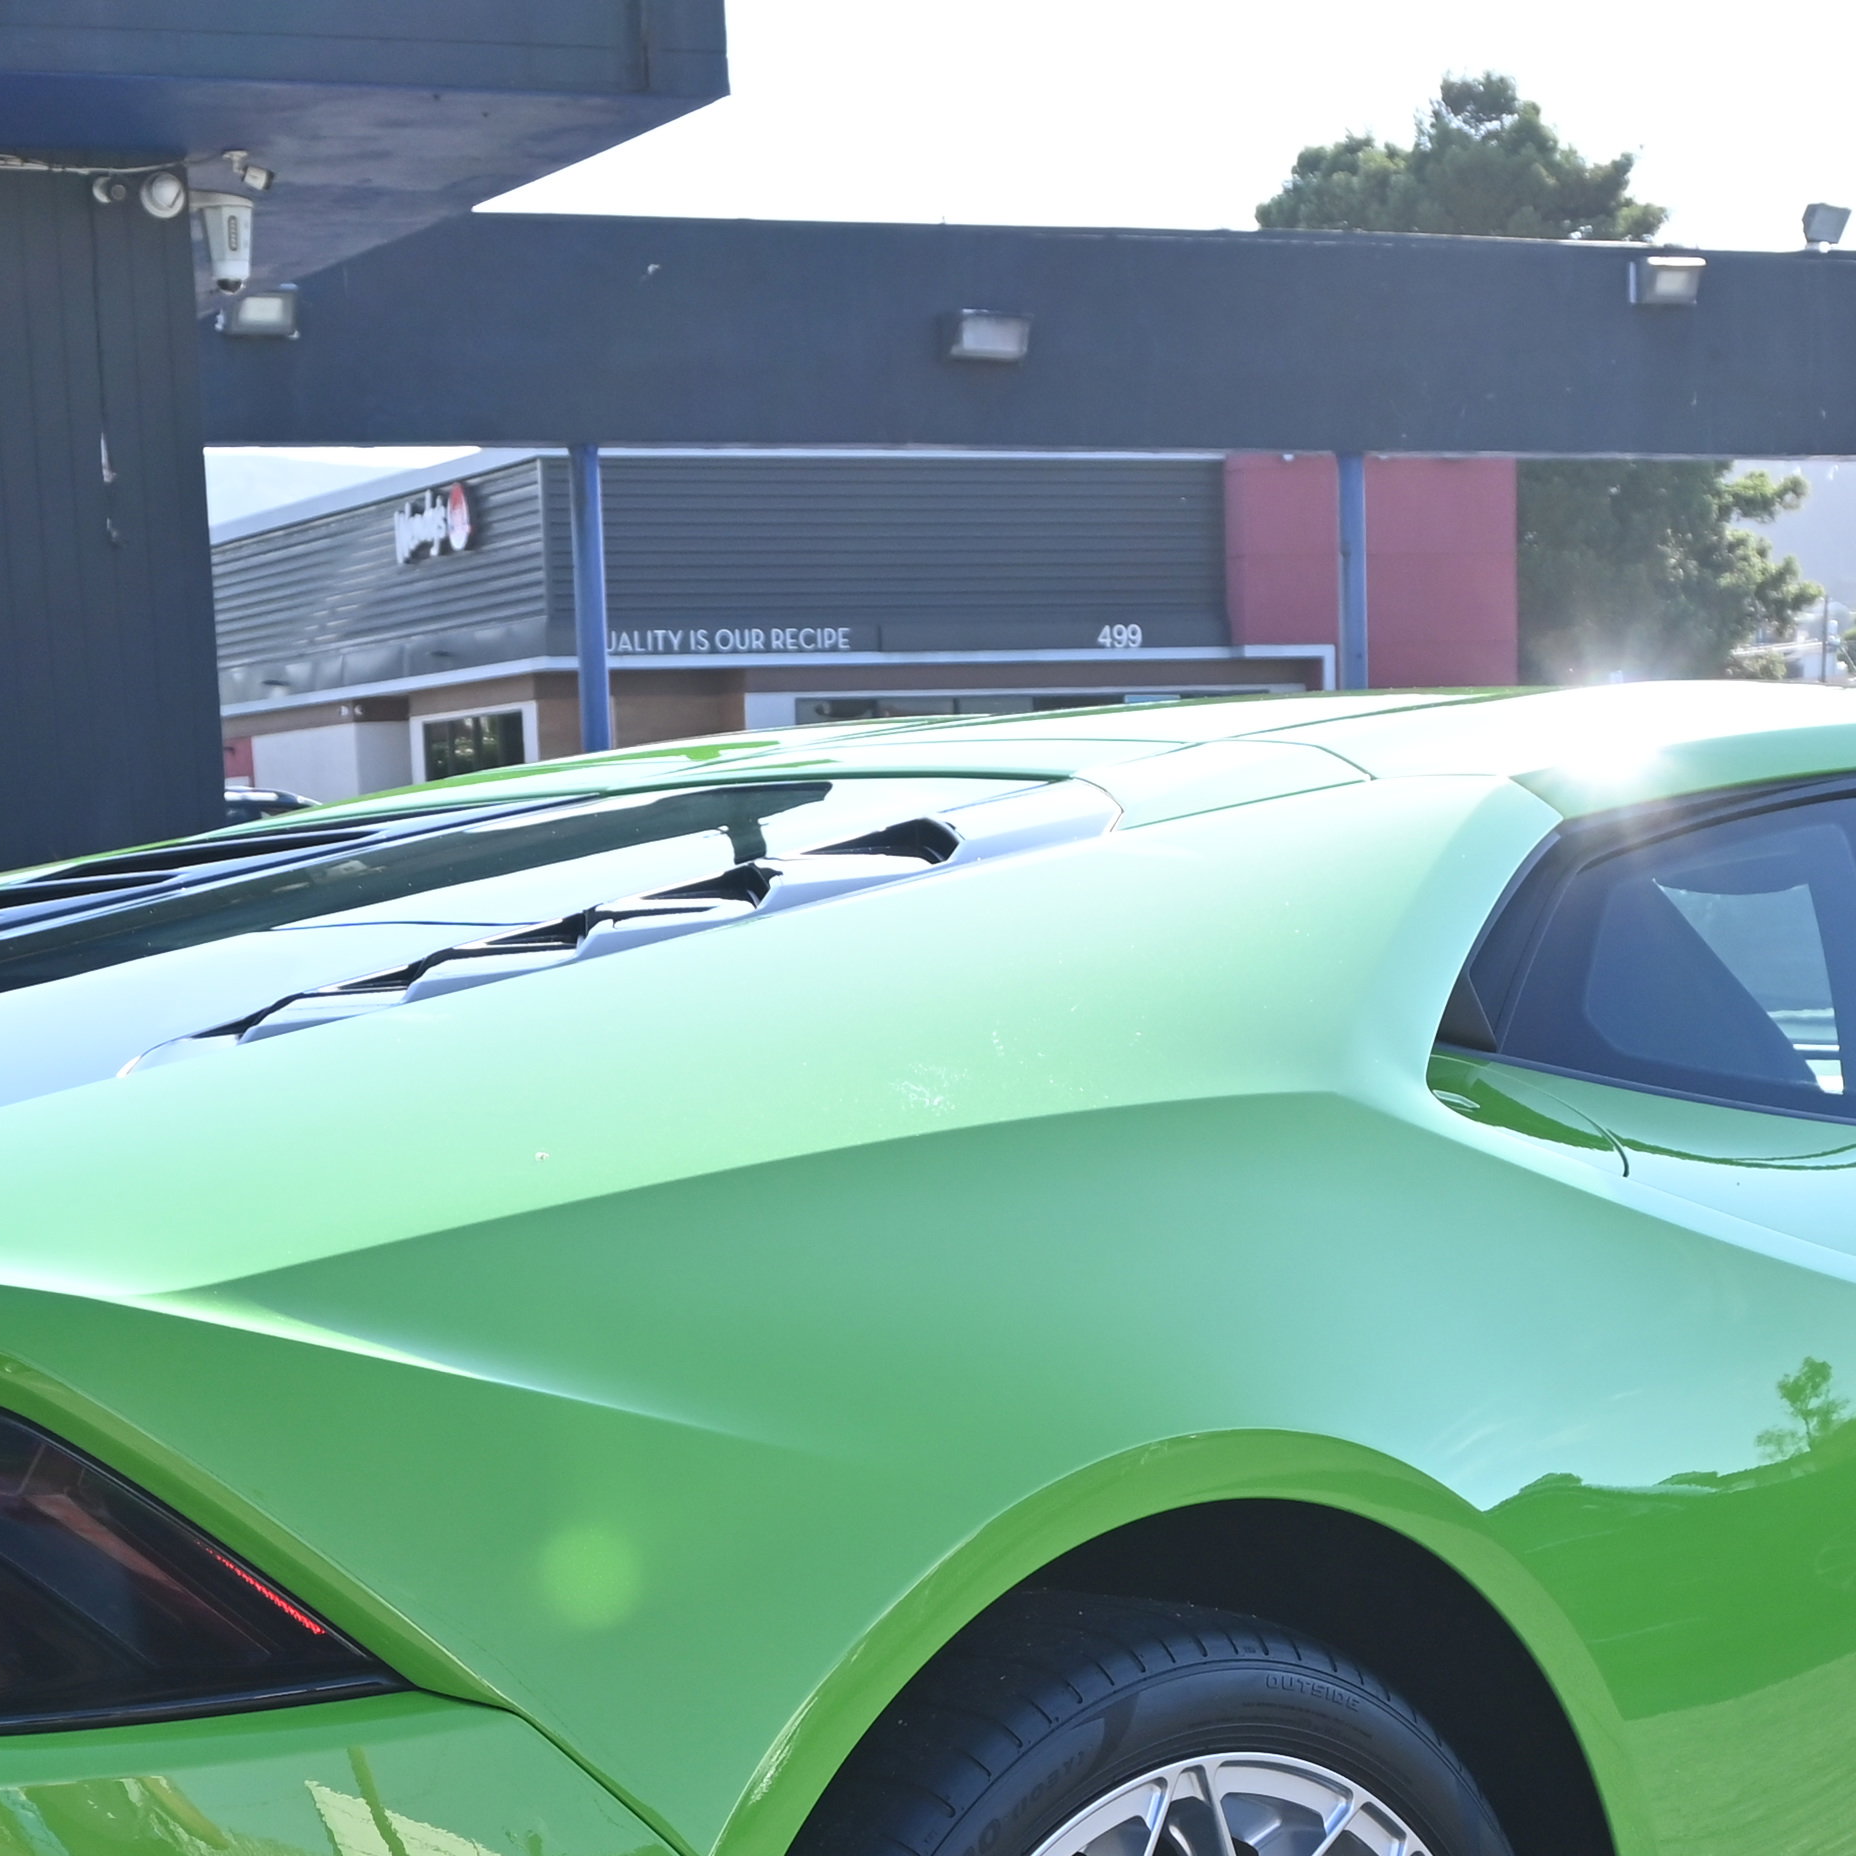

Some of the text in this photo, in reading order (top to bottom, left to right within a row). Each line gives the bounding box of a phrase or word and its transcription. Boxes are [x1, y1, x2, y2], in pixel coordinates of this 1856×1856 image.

[606, 626, 851, 653] UALITY IS OUR RECIPE
[1097, 622, 1143, 649] 499
[1265, 1673, 1361, 1713] OUTSIDE
